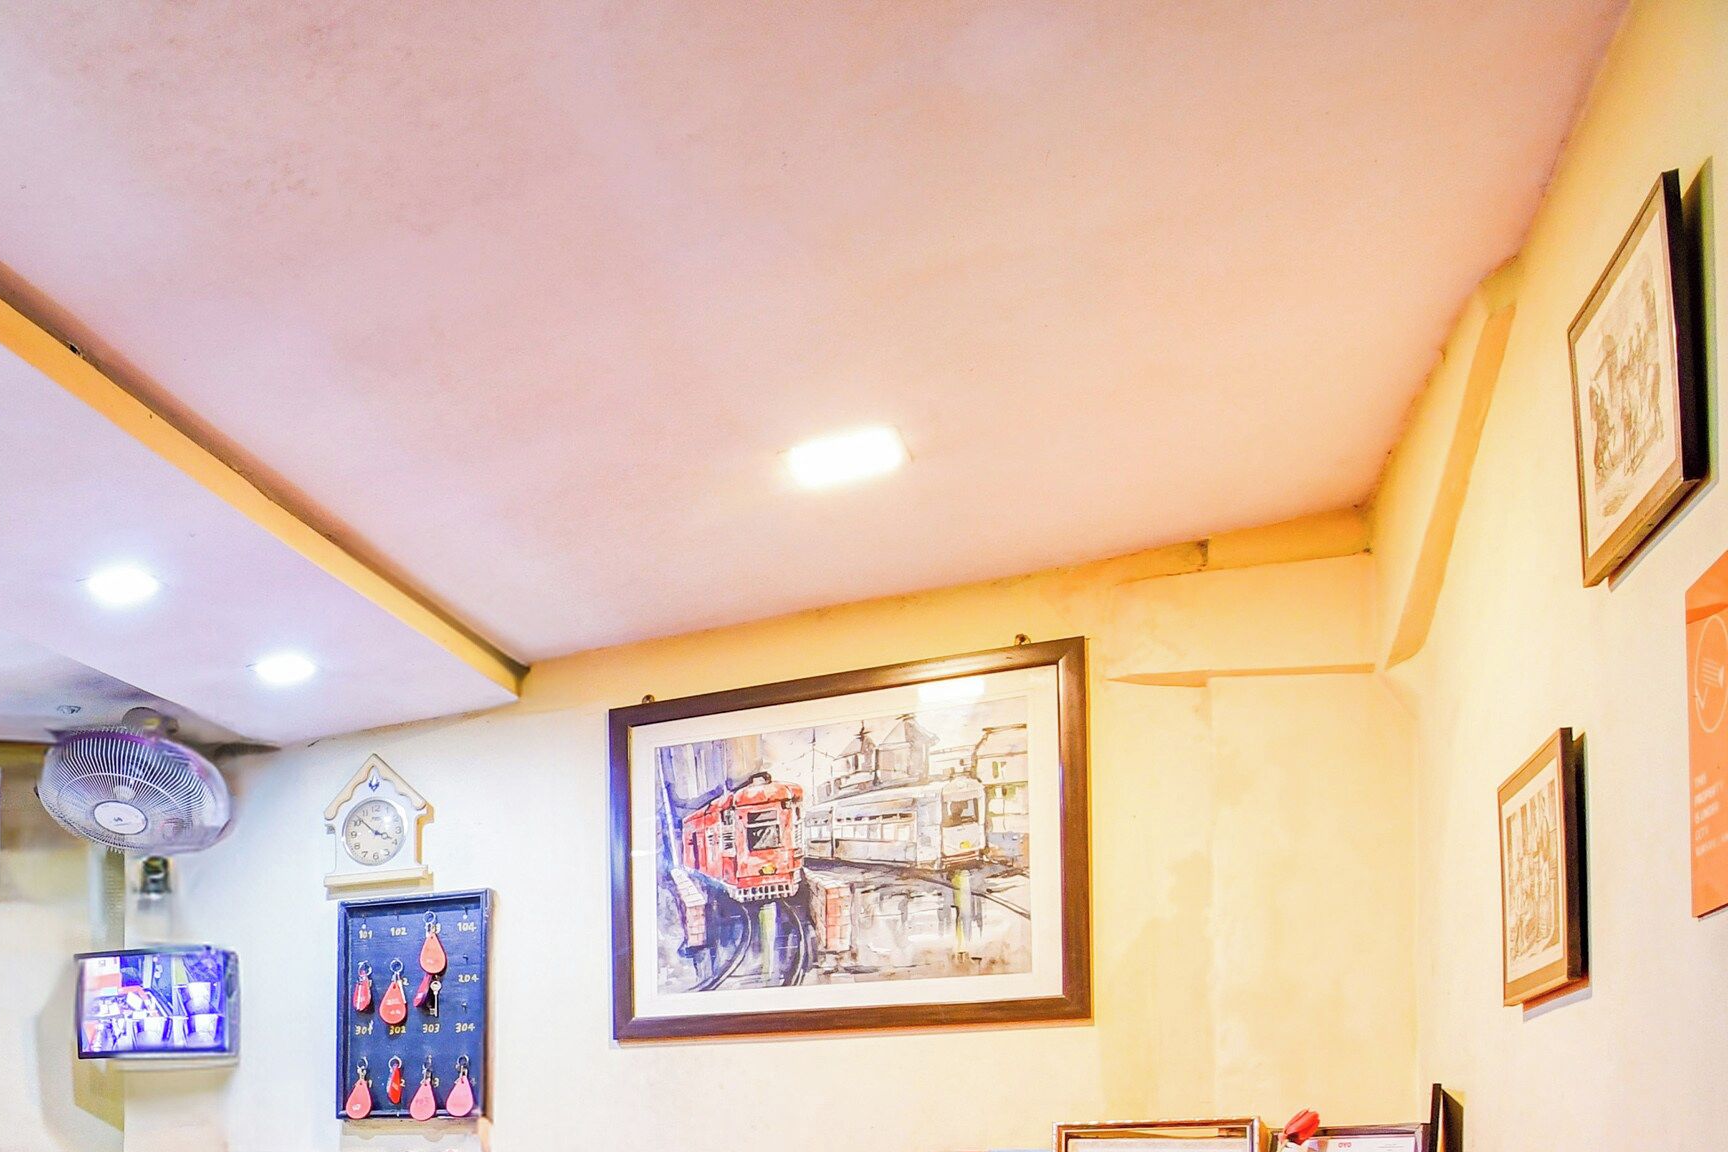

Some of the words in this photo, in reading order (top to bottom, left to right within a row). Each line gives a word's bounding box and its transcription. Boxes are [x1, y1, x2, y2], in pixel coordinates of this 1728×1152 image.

[395, 826, 402, 834] 3
[362, 850, 368, 858] 7
[372, 852, 379, 860] 6
[391, 926, 408, 936] 102
[457, 922, 477, 932] 104
[358, 929, 373, 939] 101
[458, 974, 479, 983] 204
[389, 1025, 406, 1035] 302
[422, 1023, 441, 1033] 303
[455, 1022, 475, 1033] 304
[1338, 1141, 1352, 1149] OYO
